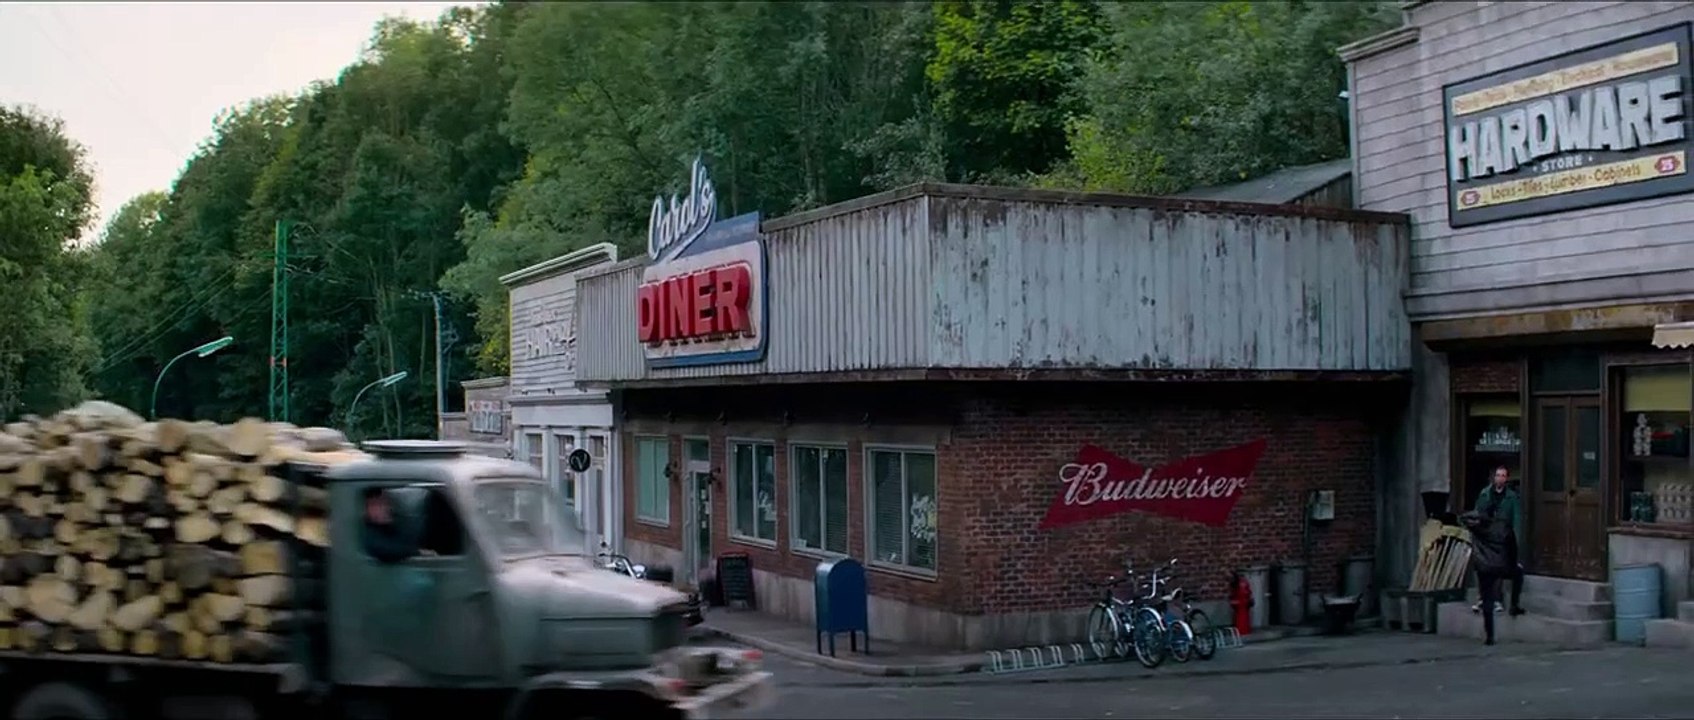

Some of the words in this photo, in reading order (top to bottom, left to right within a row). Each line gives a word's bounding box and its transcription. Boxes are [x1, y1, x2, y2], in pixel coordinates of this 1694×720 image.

[1451, 75, 1684, 181] HARDWARE
[1541, 155, 1584, 172] STORE
[1594, 163, 1642, 182] Cabinets
[648, 156, 716, 262] Carol's
[638, 262, 752, 342] DINER
[1059, 462, 1246, 505] Budweiser
